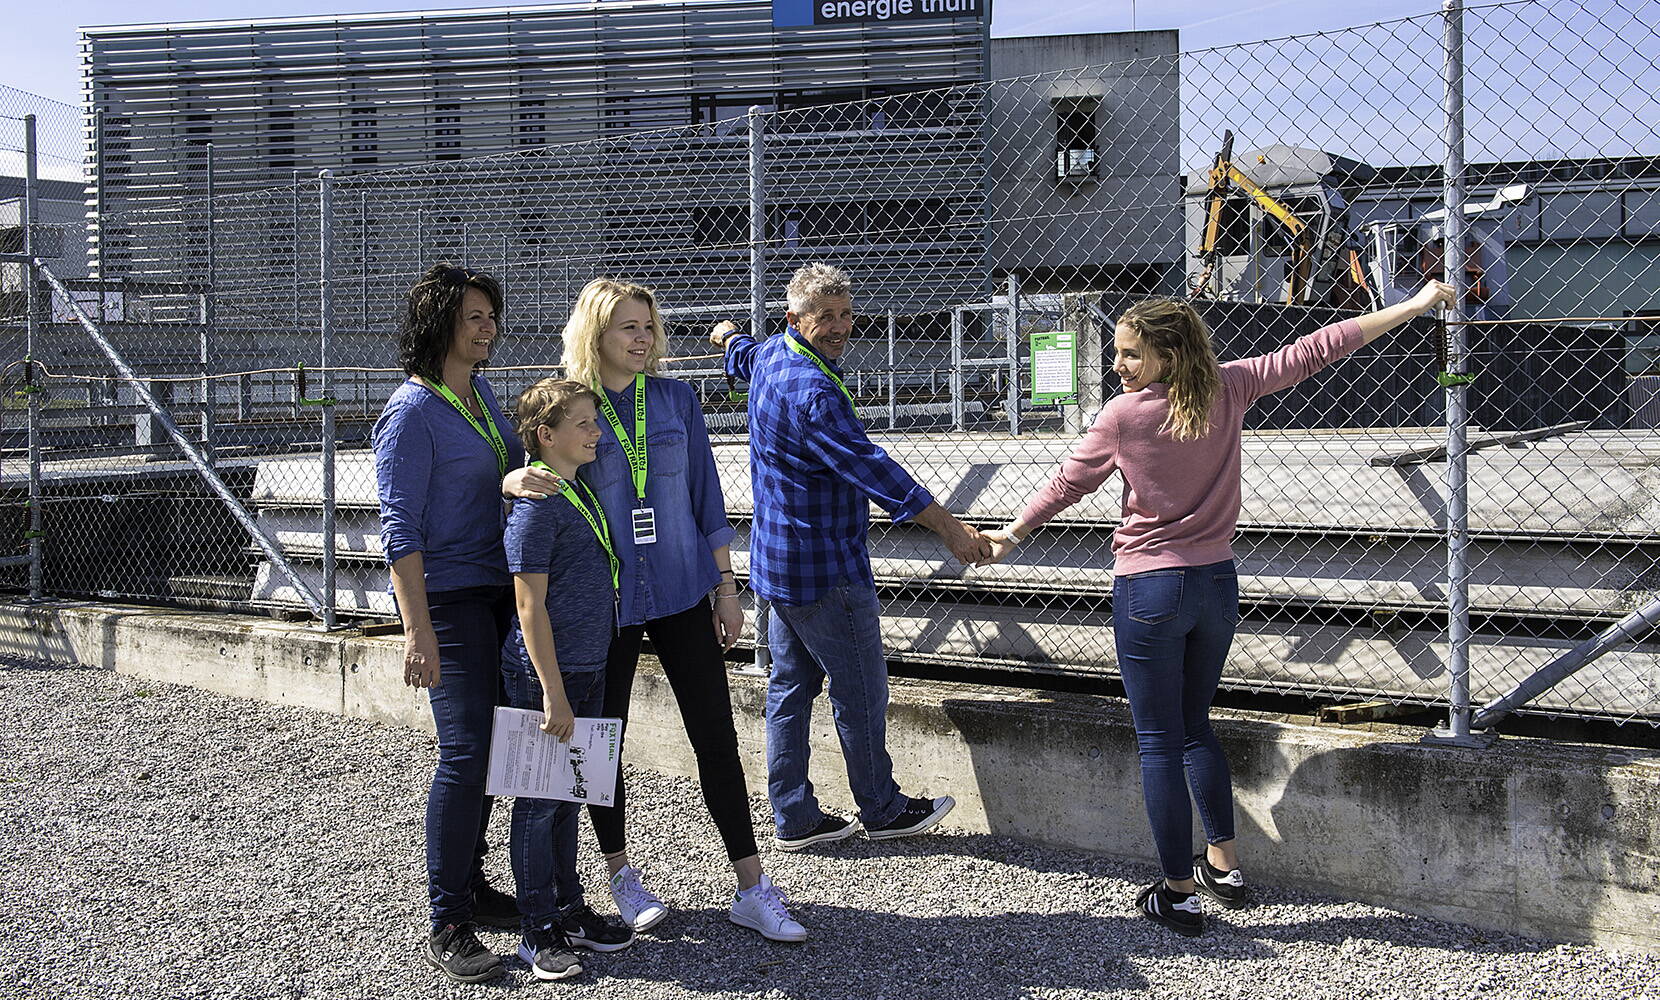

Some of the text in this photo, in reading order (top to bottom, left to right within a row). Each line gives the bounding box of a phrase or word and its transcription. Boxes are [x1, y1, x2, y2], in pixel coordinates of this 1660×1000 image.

[821, 0, 913, 20] energie
[637, 386, 645, 421] FOXTRAIL
[638, 433, 647, 471] FOXTRAIL
[608, 723, 617, 761] FOXTRAIL
